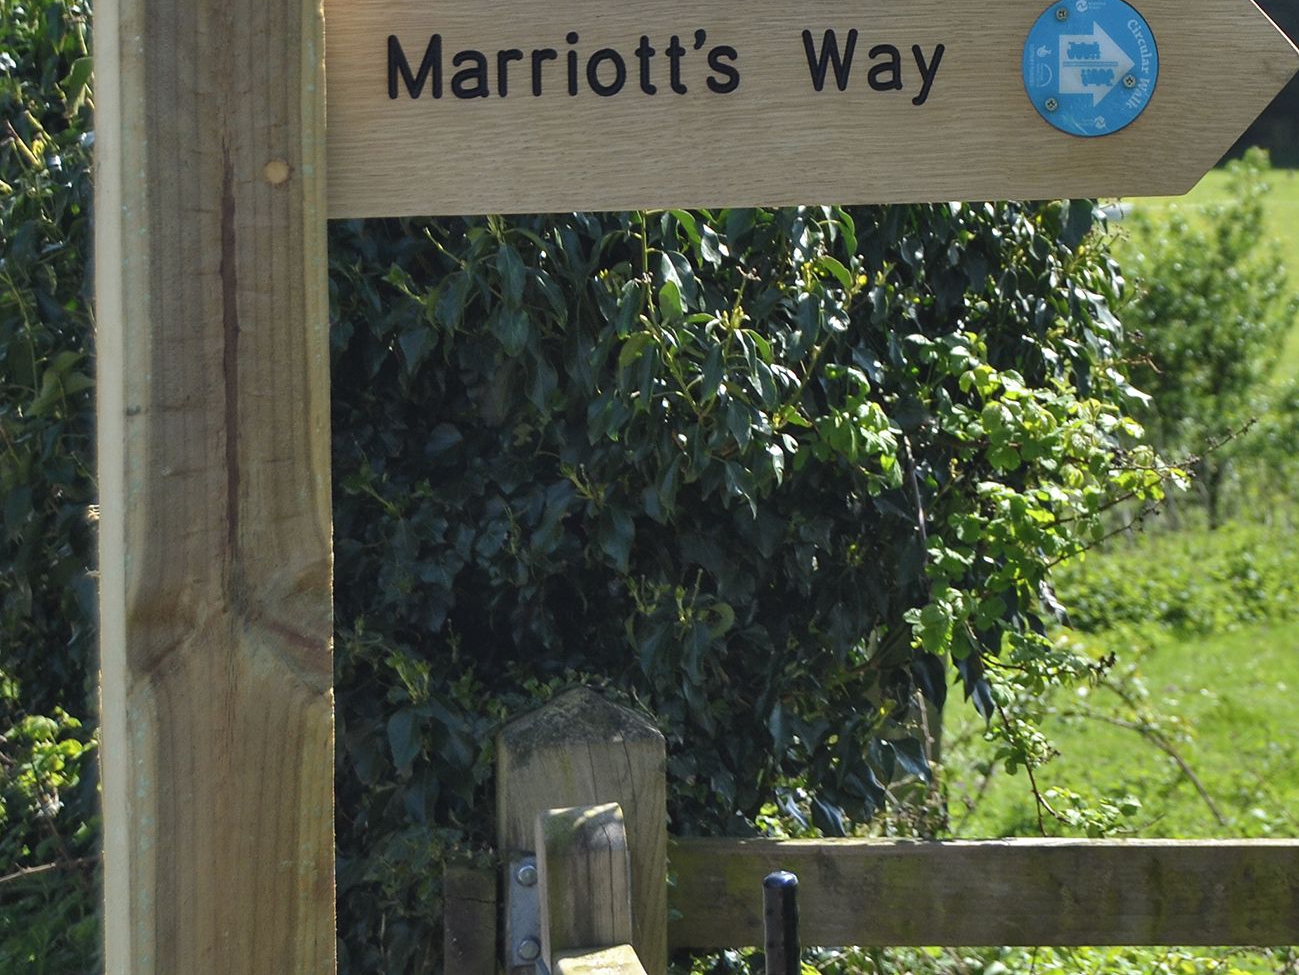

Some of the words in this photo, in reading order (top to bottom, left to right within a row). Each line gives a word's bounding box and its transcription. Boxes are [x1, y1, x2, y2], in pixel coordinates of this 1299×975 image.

[387, 28, 741, 100] Marriott's
[801, 27, 946, 107] Way
[1127, 18, 1153, 75] Circular
[1126, 77, 1151, 109] Walk
